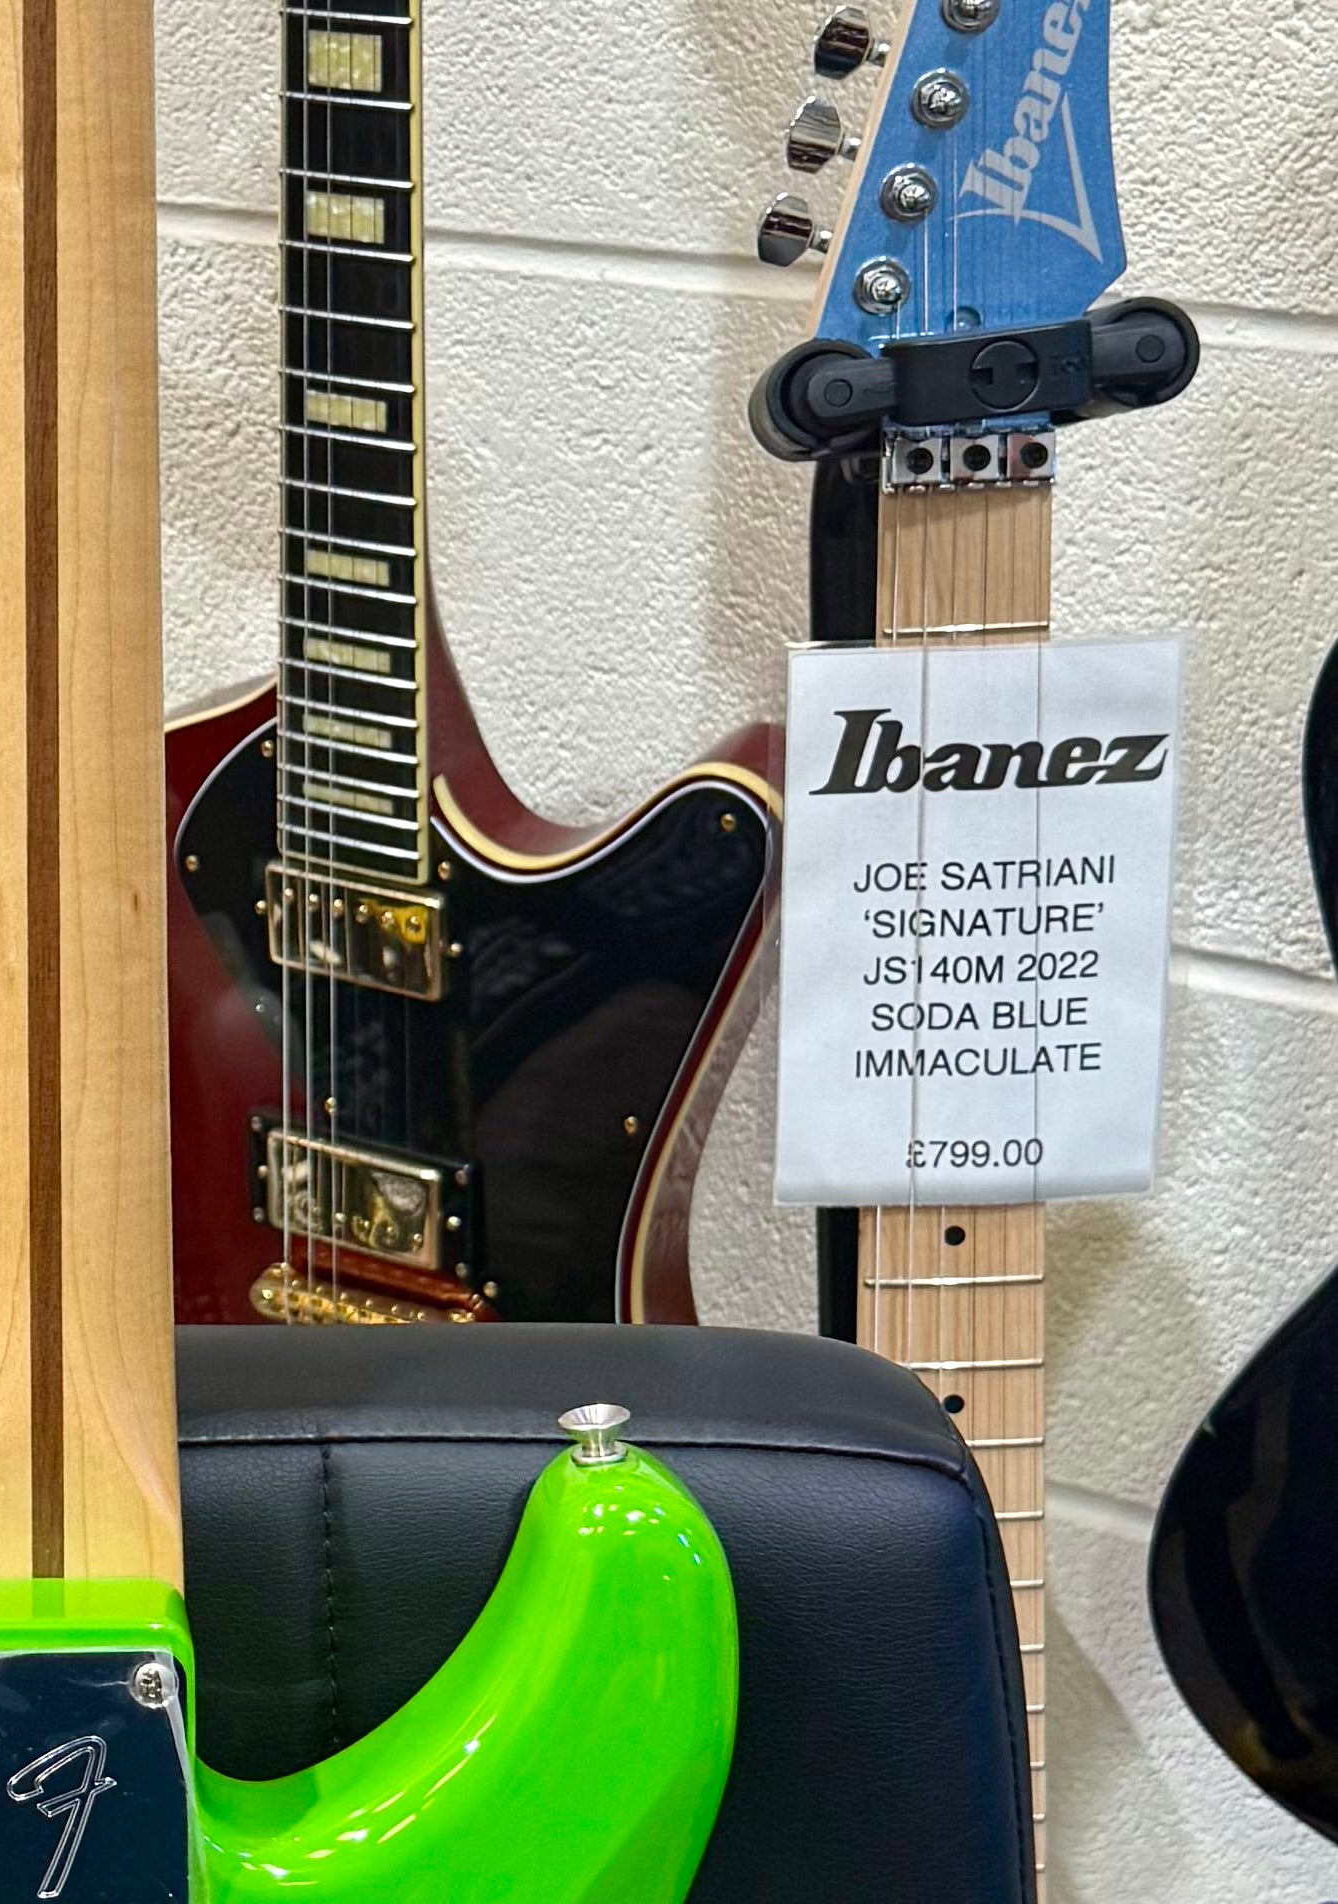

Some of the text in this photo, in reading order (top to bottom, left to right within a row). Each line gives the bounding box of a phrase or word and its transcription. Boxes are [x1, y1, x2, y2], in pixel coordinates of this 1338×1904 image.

[809, 708, 1170, 796] Ibanez
[853, 855, 1114, 893] JOE SATRIANI
[863, 950, 1099, 985] JS140M 2022
[871, 997, 1088, 1031] SODA BLUE
[856, 1042, 1102, 1078] IMMACULATE
[906, 1138, 1044, 1169] £799.00
